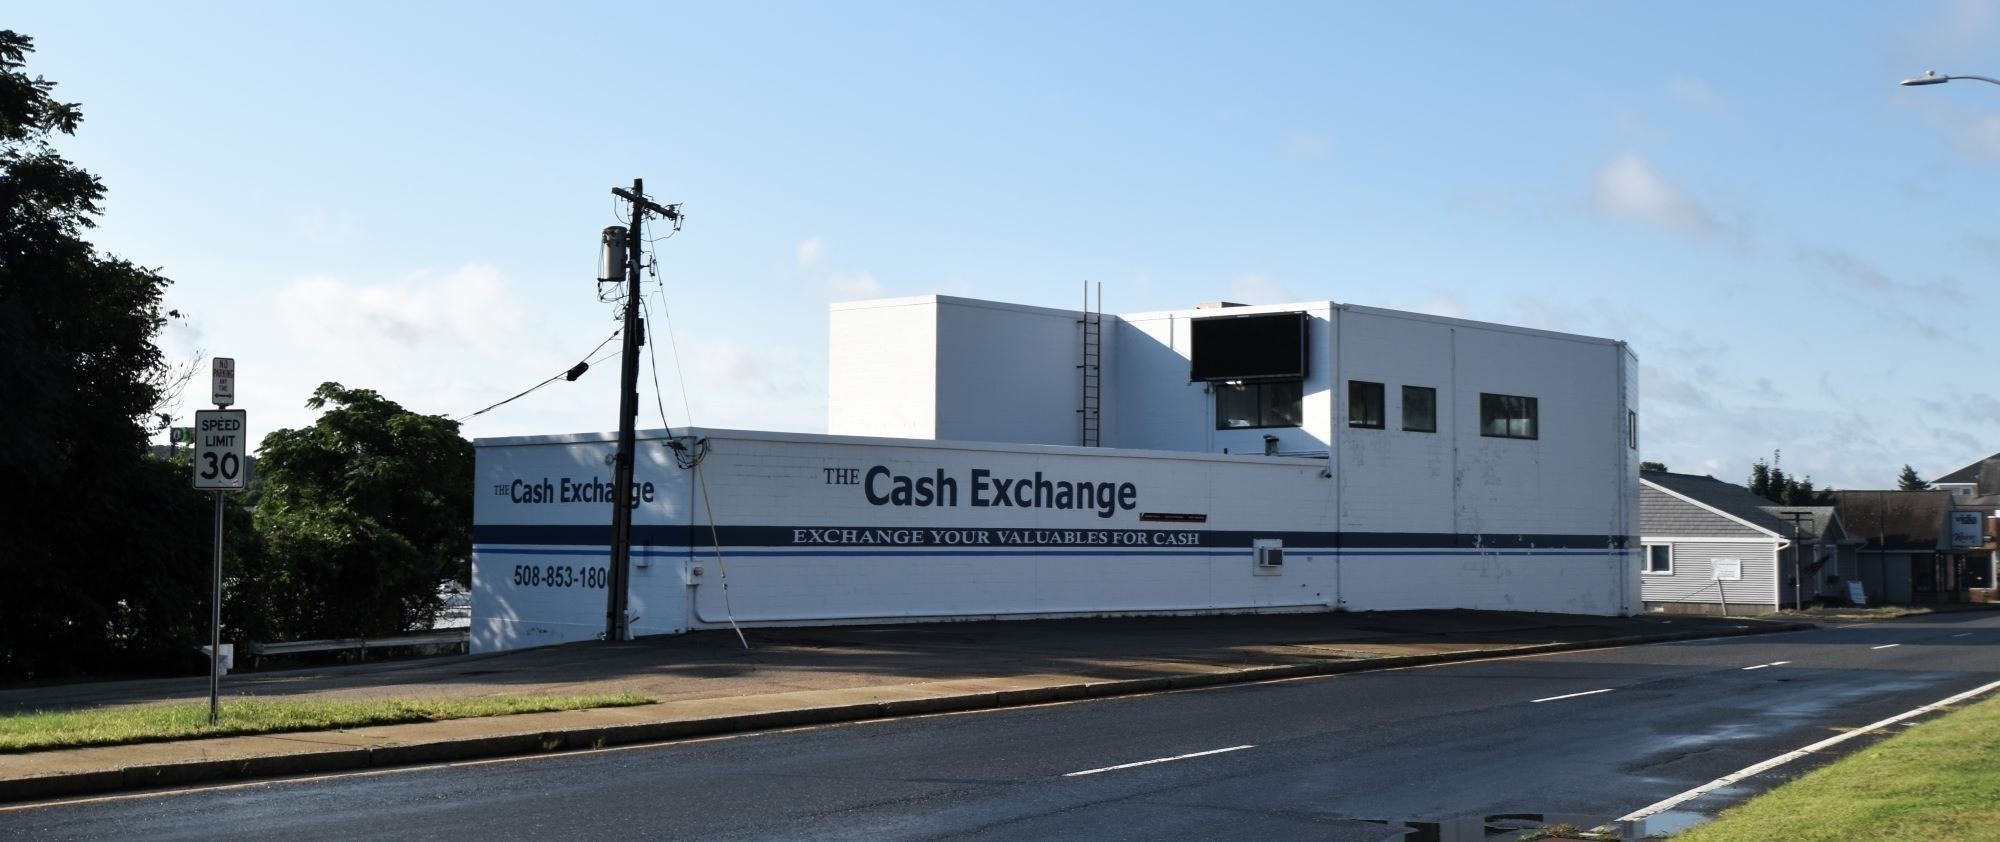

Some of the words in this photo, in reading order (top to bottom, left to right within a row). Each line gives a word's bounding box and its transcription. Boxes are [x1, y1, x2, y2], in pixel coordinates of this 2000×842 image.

[219, 360, 229, 369] NO
[213, 369, 235, 379] PARKING
[201, 420, 241, 432] SPEED
[205, 435, 236, 448] LIMIT
[201, 452, 240, 480] 30
[493, 484, 511, 496] THE
[510, 477, 554, 504] Cash
[560, 476, 655, 509] Exchage
[823, 467, 860, 485] THE
[864, 465, 958, 507] Cash
[970, 469, 1137, 519] Exchange
[792, 529, 925, 544] EXCHANGE
[930, 530, 991, 545] YOUR
[997, 530, 1108, 545] VALUABLES
[1112, 532, 1148, 545] FOR
[1153, 532, 1200, 545] CASH
[514, 564, 611, 590] 508-853-180
